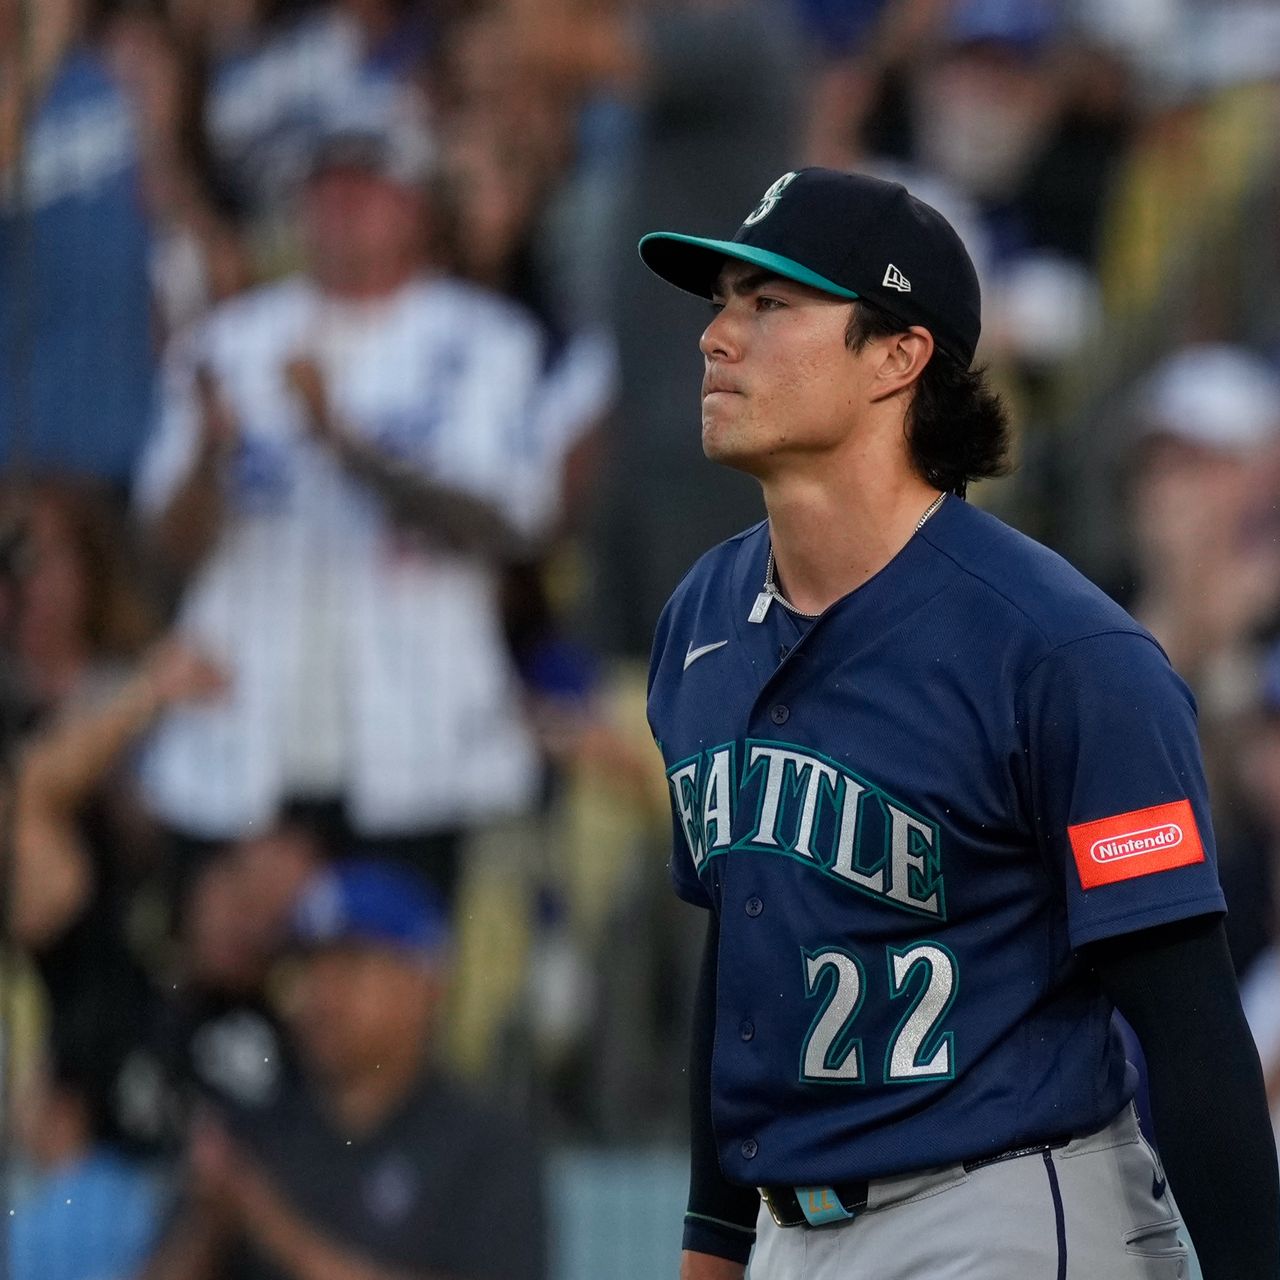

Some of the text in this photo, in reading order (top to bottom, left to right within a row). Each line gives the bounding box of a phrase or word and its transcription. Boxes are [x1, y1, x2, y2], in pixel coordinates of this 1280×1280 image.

[664, 738, 947, 922] EATTLE
[1098, 831, 1174, 859] Nintendo
[799, 940, 960, 1085] 22
